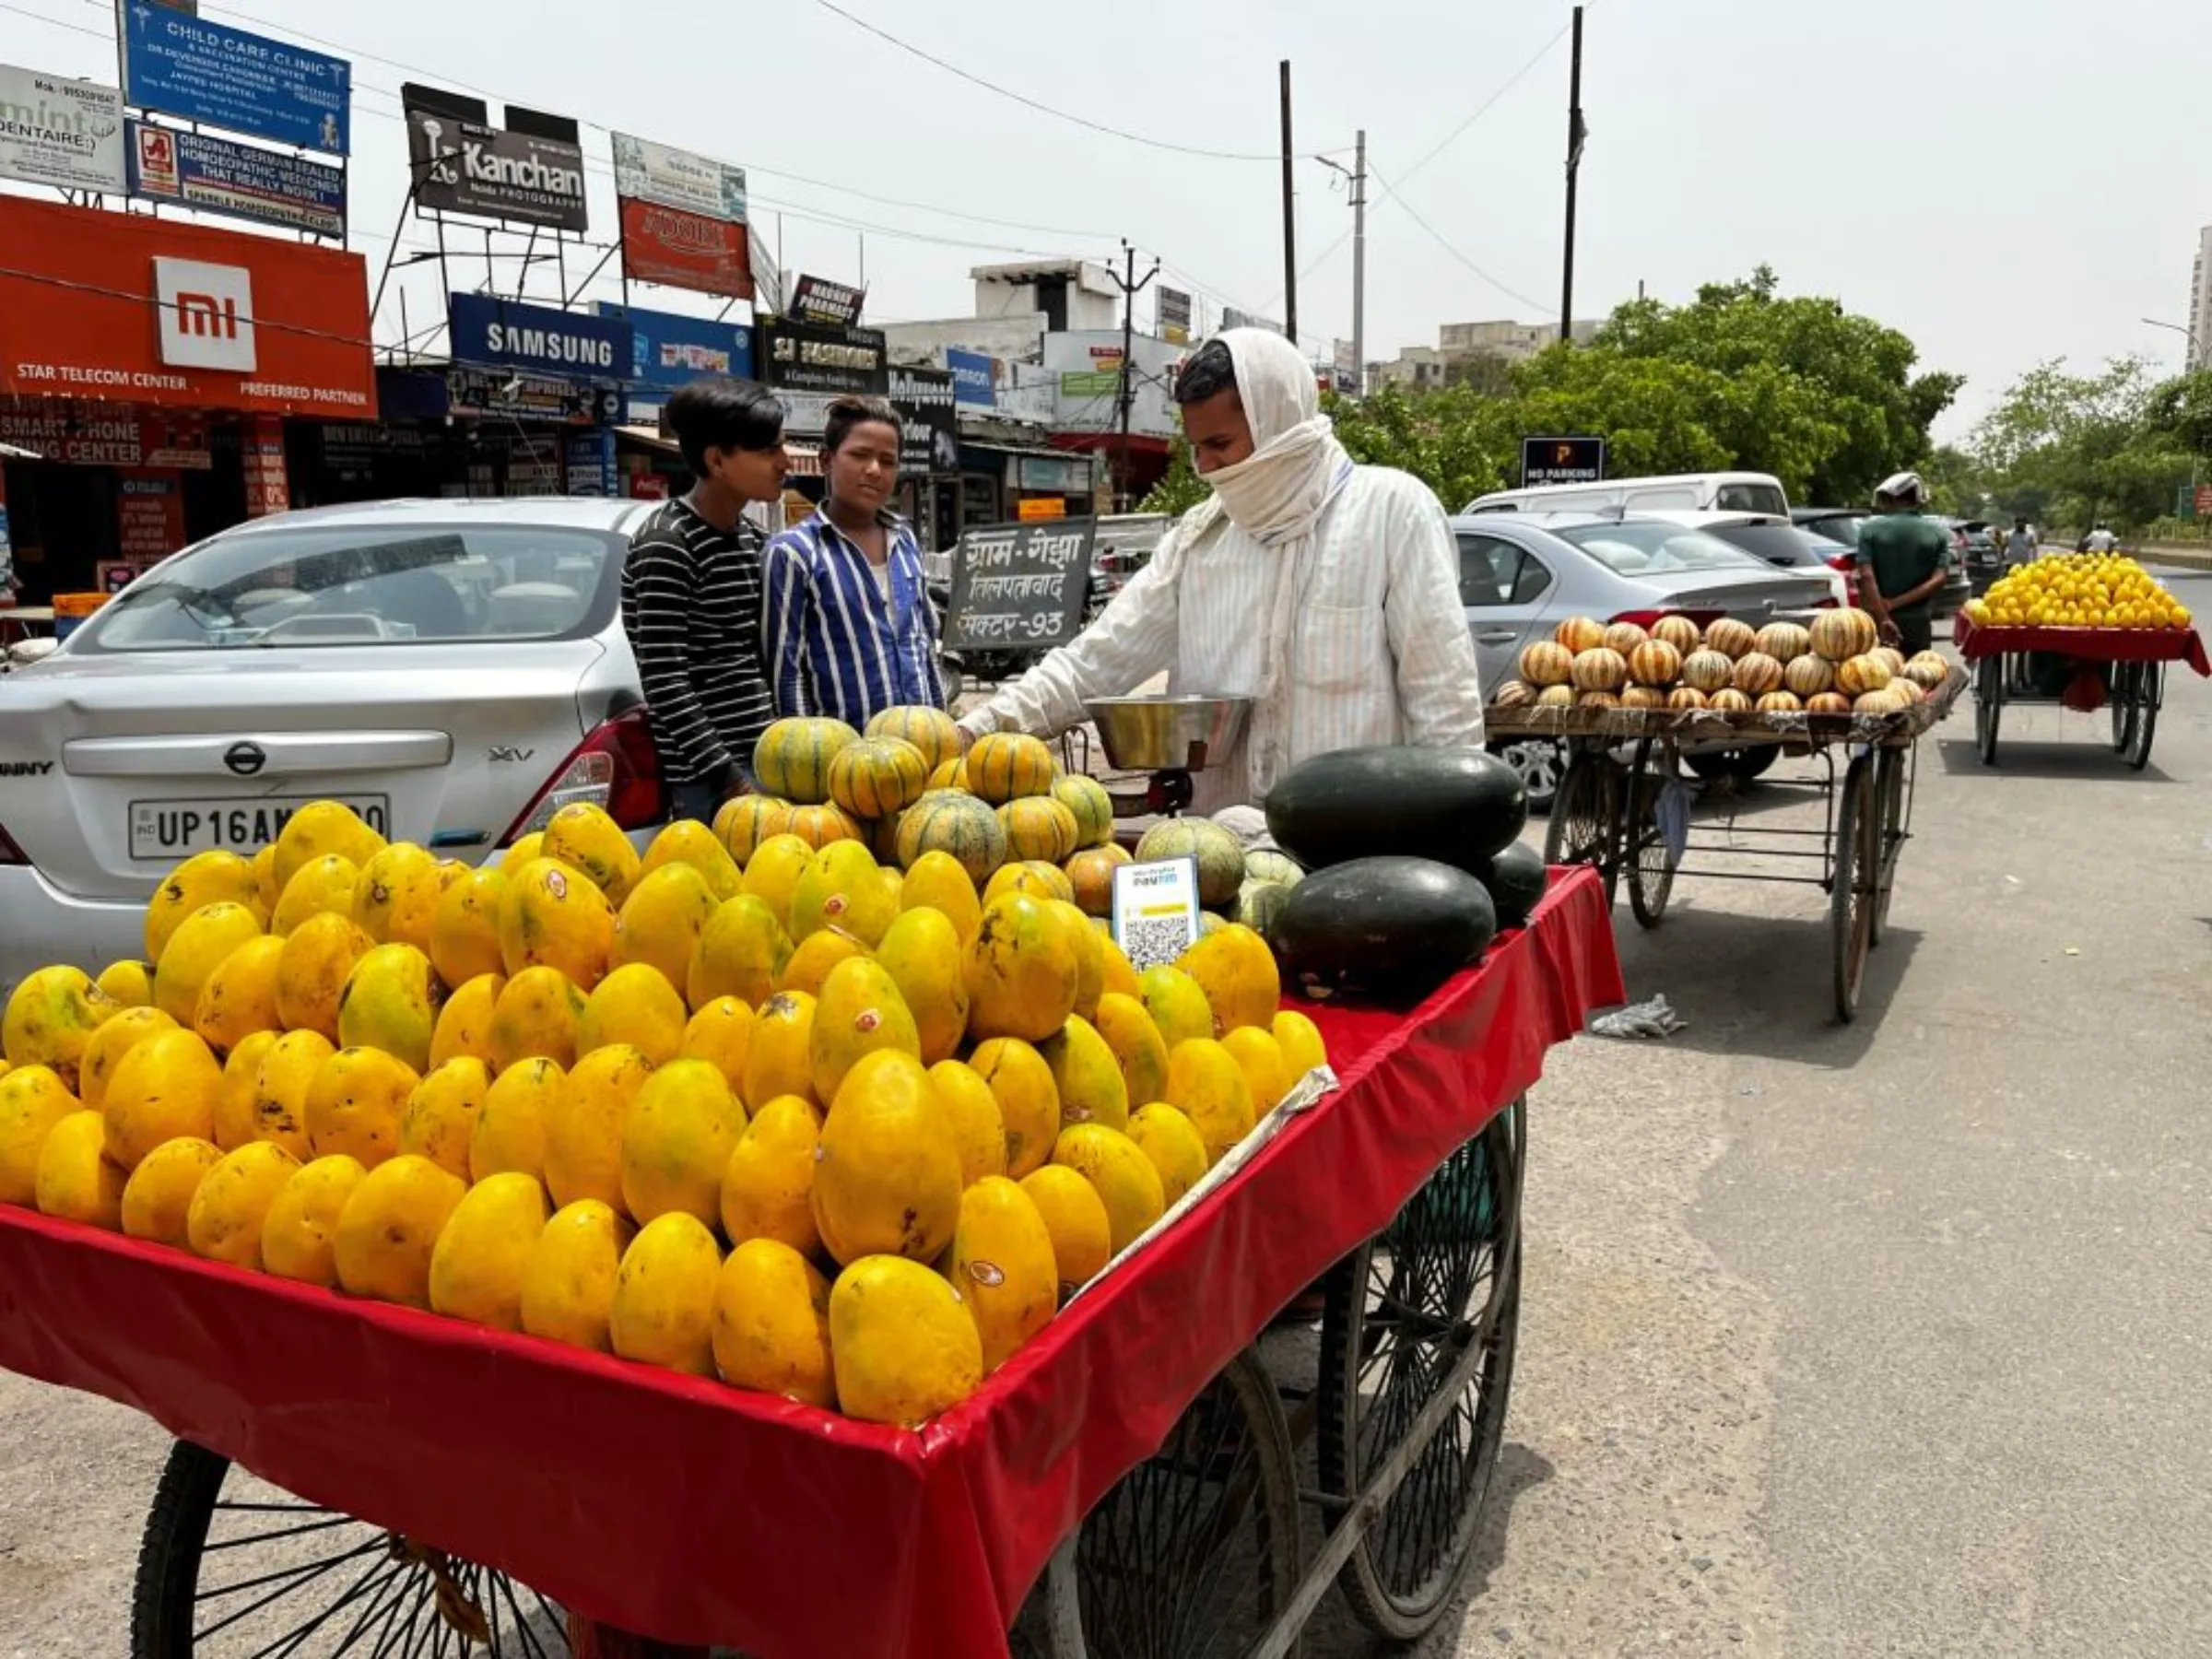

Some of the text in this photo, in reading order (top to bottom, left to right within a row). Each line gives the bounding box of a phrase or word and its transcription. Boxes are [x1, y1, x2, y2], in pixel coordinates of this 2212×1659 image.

[168, 21, 218, 47] CHILD
[224, 39, 269, 58] CARE
[274, 52, 325, 76] CLINIC
[179, 135, 238, 159] ORIGINAL
[241, 146, 292, 171] GERMAN
[201, 164, 232, 181] THAT
[462, 141, 582, 198] Kanchan
[487, 323, 612, 367] SAMSUNG
[17, 363, 187, 391] STAR TELECOM CENTER
[240, 381, 368, 406] PREFERRED PARTNER
[888, 371, 954, 412] Hollywood
[1, 417, 67, 437] SMART
[66, 441, 142, 462] CENTER
[1528, 468, 1596, 478] NO PARKING
[489, 746, 534, 761] XV
[0, 760, 53, 776] NNY
